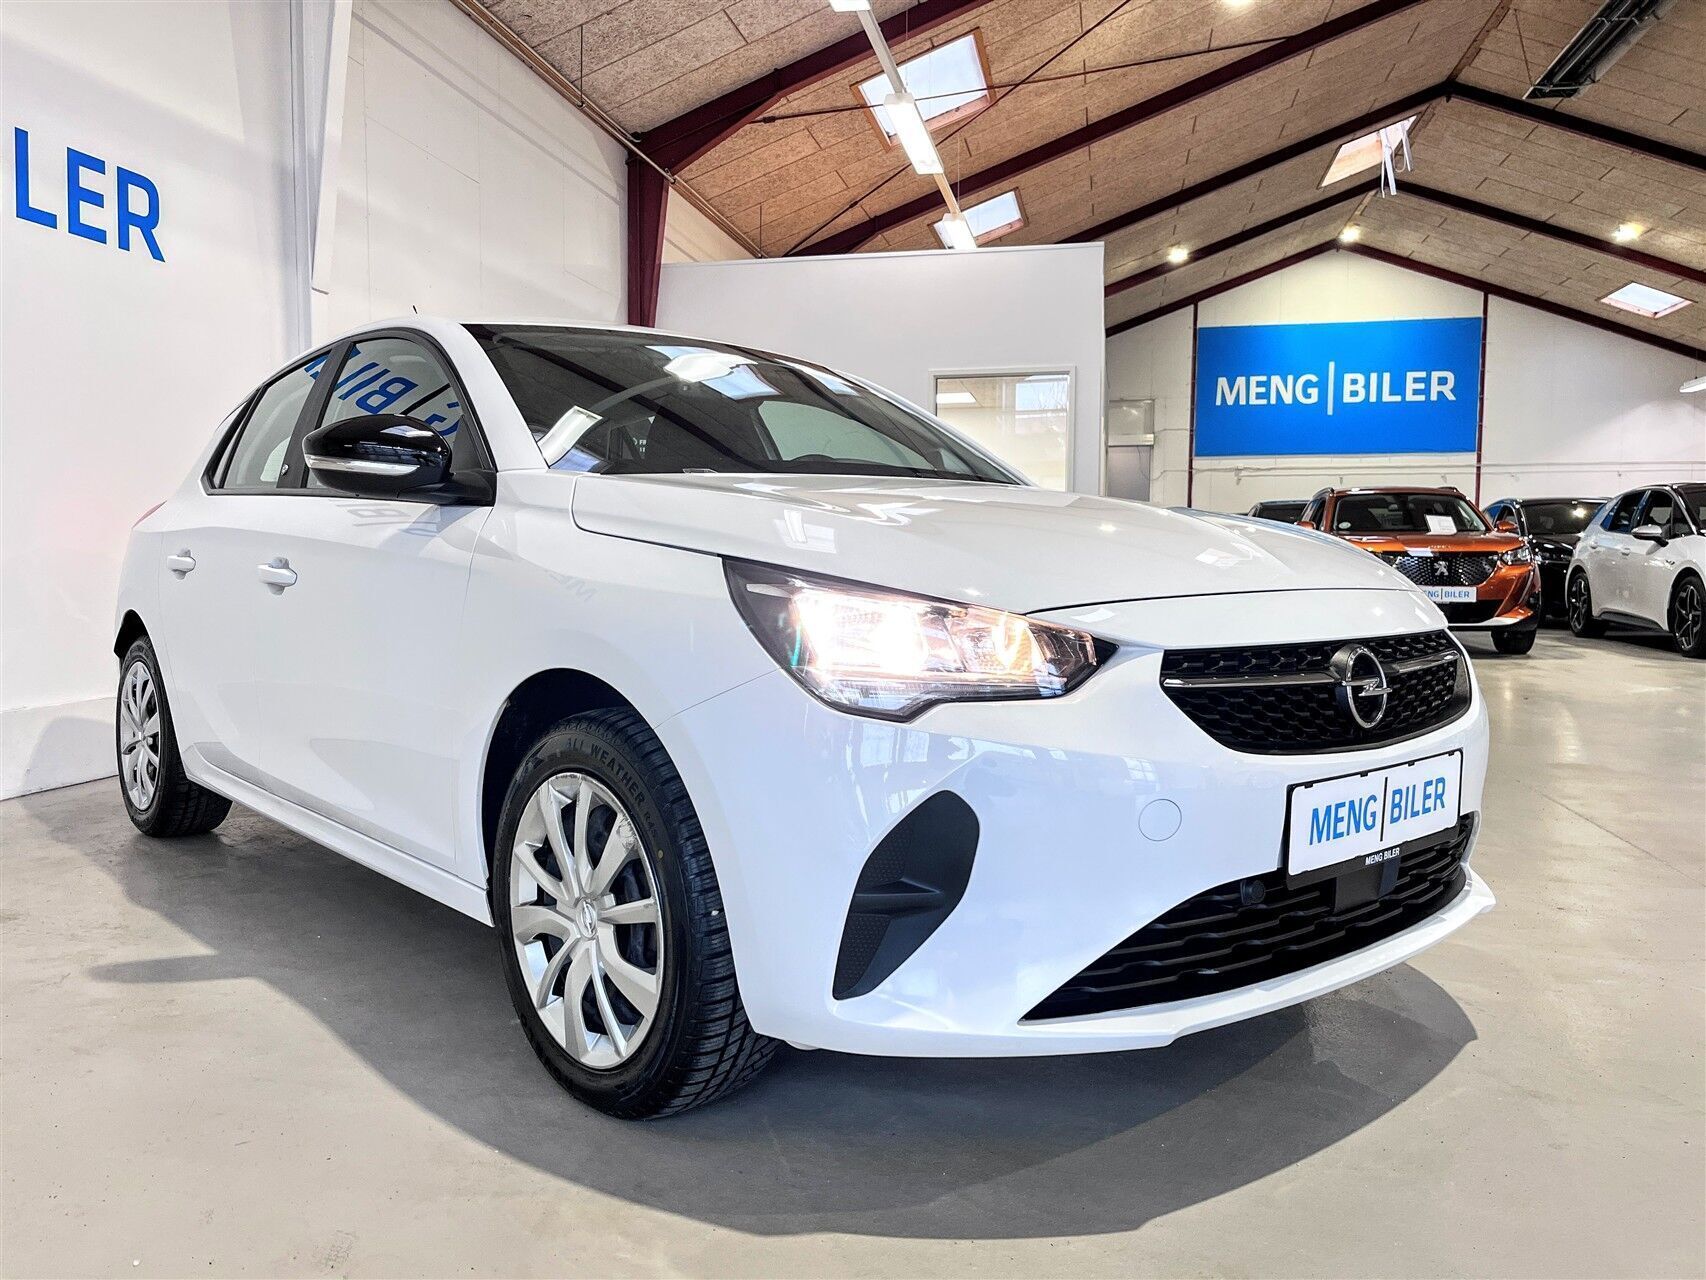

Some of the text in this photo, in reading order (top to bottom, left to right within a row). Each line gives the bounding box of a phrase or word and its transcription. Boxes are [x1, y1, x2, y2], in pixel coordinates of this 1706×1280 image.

[1215, 371, 1457, 405] MENG BILER
[1444, 590, 1470, 598] BILER
[567, 737, 584, 750] ALL
[590, 743, 646, 807] WEATHER
[1309, 776, 1447, 846] MENG BILER
[1365, 847, 1400, 865] MENG BILER
